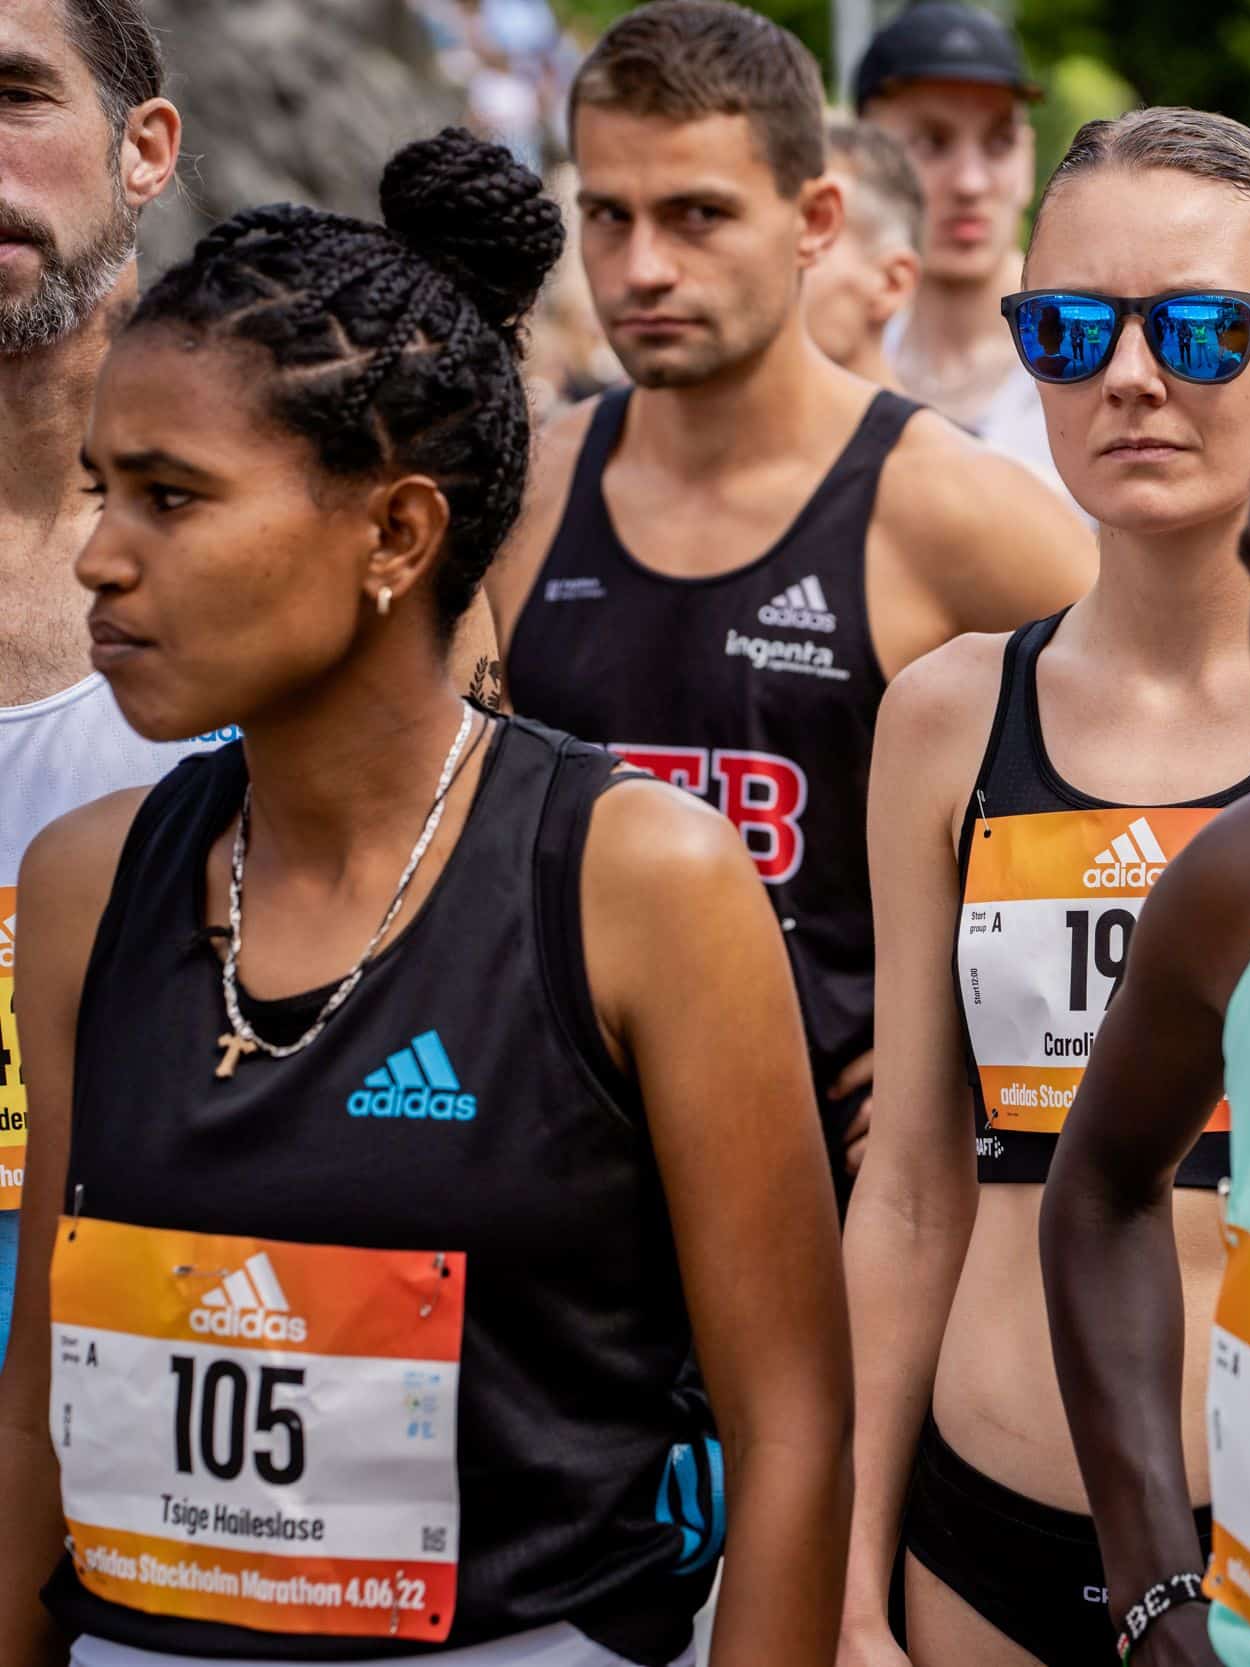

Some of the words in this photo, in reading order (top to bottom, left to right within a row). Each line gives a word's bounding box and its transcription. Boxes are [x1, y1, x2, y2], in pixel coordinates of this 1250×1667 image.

[758, 604, 836, 633] adidas
[725, 629, 833, 669] ingenta
[991, 911, 1002, 933] A
[347, 1084, 477, 1121] adidas
[1000, 1082, 1038, 1107] adidas
[189, 1307, 307, 1342] adidas
[86, 1341, 98, 1367] A
[171, 1355, 306, 1486] 105
[161, 1494, 208, 1536] Tsige
[213, 1504, 325, 1541] Haileslase
[139, 1554, 239, 1597] Stockholm
[241, 1569, 342, 1607] Marathon
